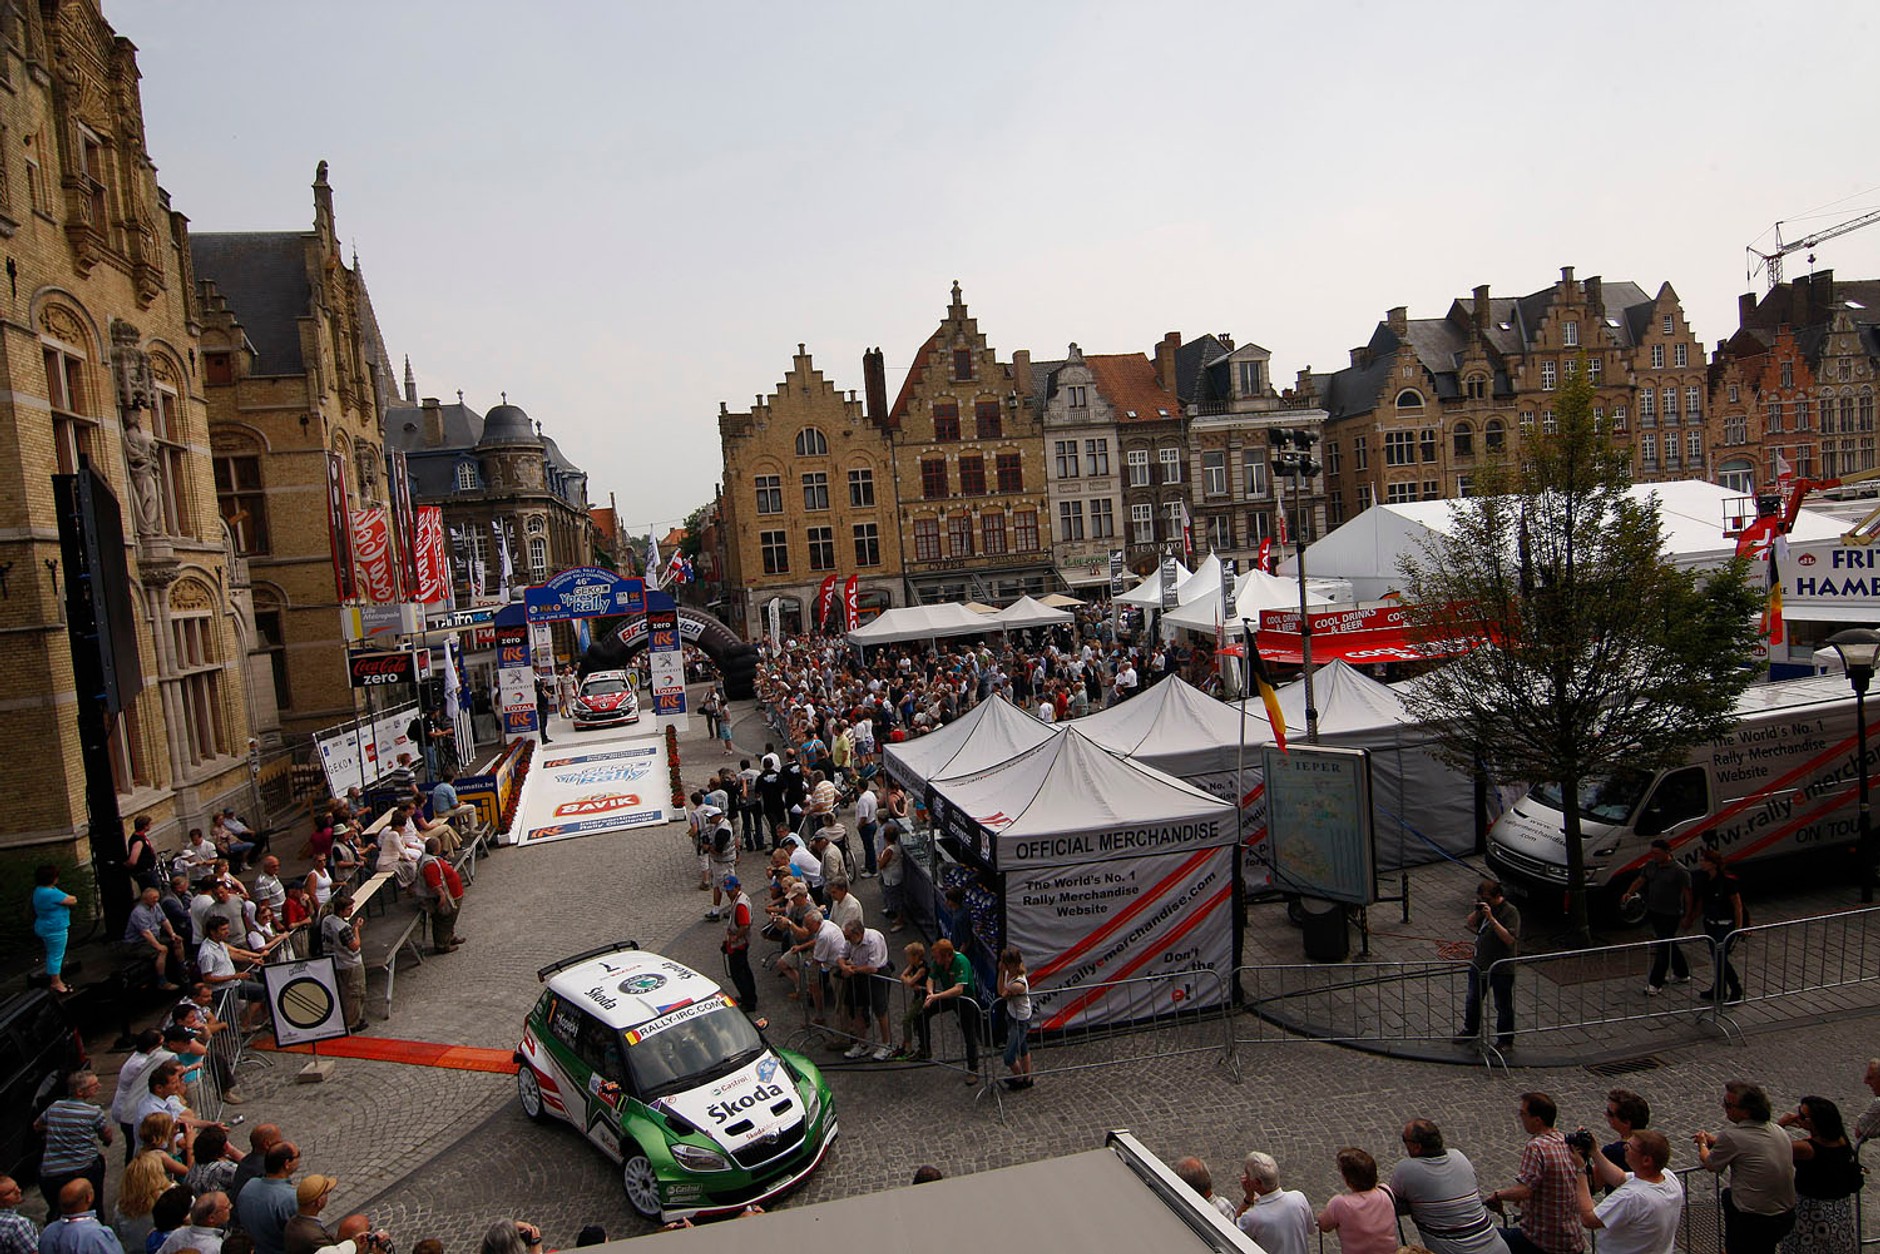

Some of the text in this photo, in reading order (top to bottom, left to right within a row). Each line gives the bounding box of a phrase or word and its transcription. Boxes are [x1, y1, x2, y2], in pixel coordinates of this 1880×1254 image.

[1159, 541, 1182, 550] ROO
[560, 593, 592, 607] Ypres
[573, 594, 610, 614] Rally
[1314, 609, 1377, 629] COOL DRINKS
[1331, 620, 1364, 634] & BEER
[354, 656, 408, 676] Coca-Cola
[363, 672, 398, 685] zero
[506, 703, 533, 712] TOTAL
[1739, 726, 1788, 743] World's
[1792, 723, 1814, 737] No.
[1817, 720, 1825, 731] 1
[1713, 738, 1826, 767] Rally Merchandise
[1296, 761, 1342, 773] IEPER
[1717, 766, 1768, 783] Website
[454, 782, 494, 792] formatix.be
[1016, 821, 1219, 860] OFFICIAL MERCHANDISE
[1795, 825, 1821, 844] ON
[1025, 871, 1136, 891] The World's No. 1
[1023, 886, 1140, 907] Rally Merchandise
[1056, 904, 1108, 918] Website
[1164, 948, 1200, 963] Don't
[1191, 961, 1215, 973] the
[584, 985, 617, 1011] Škoda
[639, 999, 721, 1037] RALLY-IRC.COM
[720, 1074, 751, 1093] Castrol
[706, 1084, 784, 1125] Škoda
[676, 1185, 701, 1194] Castrol
